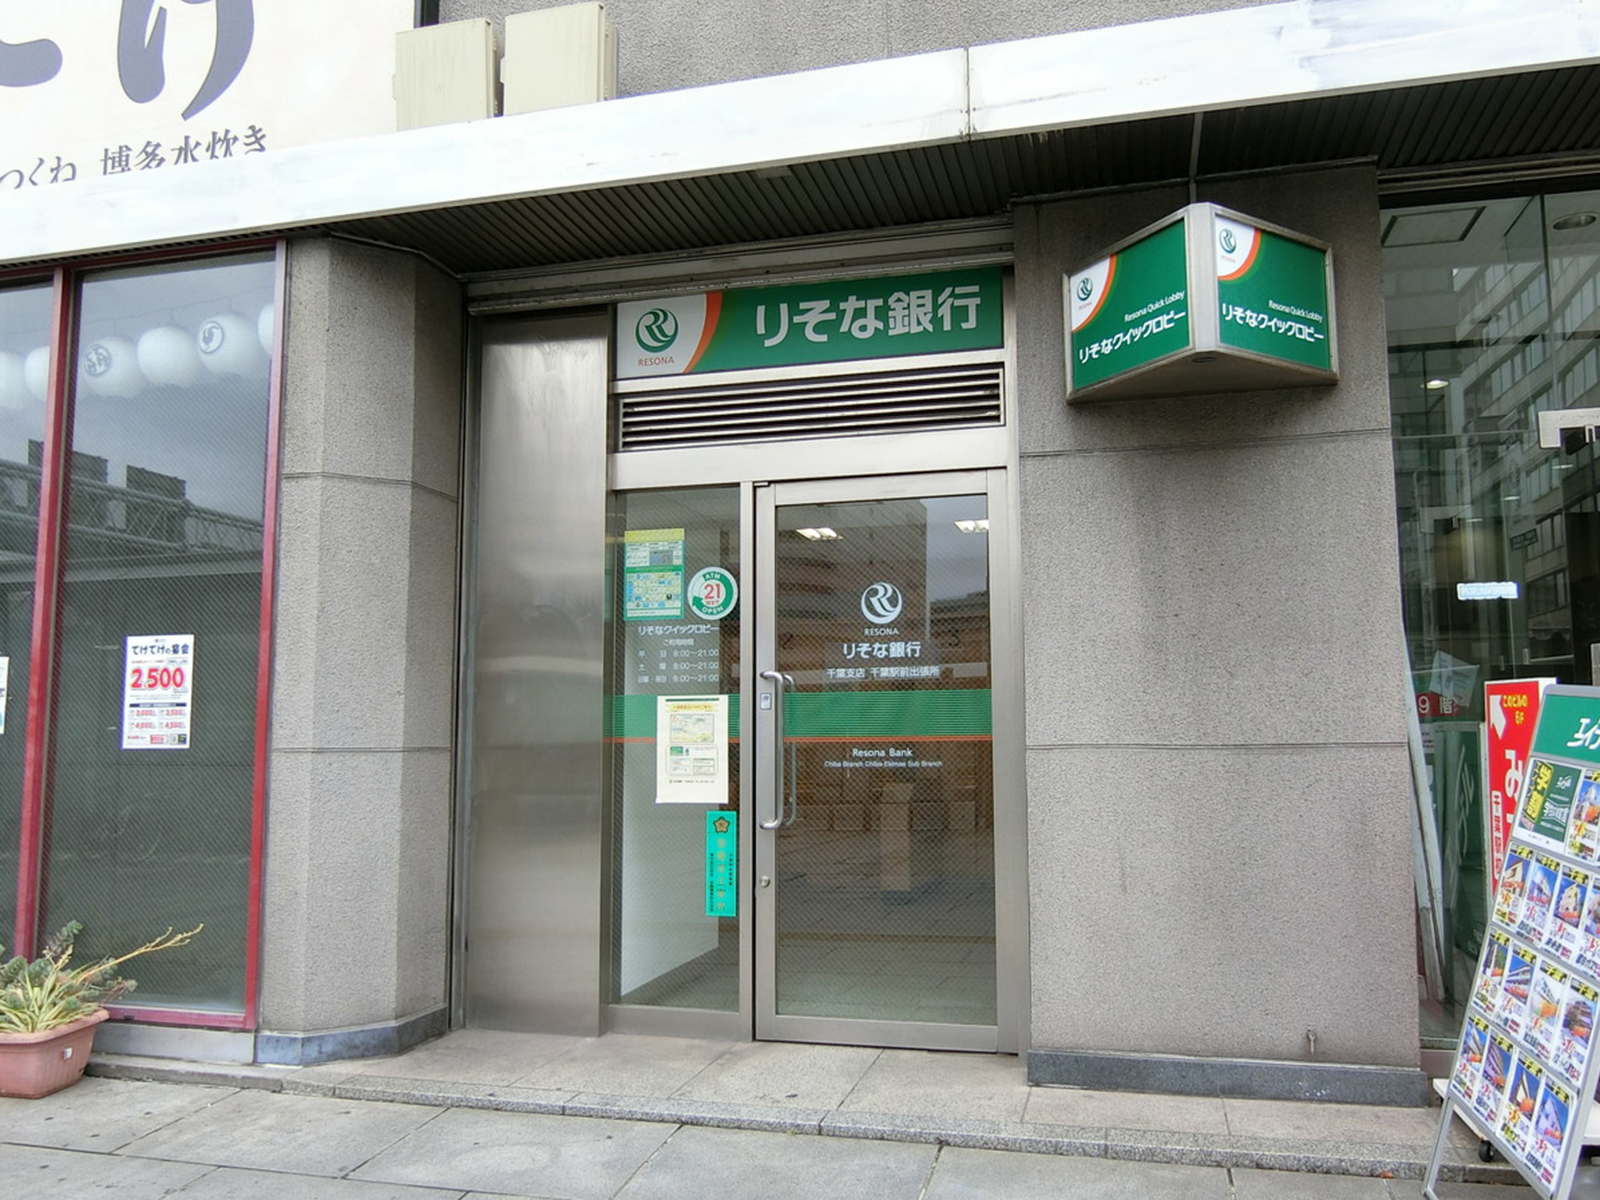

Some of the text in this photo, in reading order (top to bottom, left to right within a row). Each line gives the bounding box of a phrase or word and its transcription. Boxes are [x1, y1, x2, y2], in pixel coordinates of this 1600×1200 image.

[100, 125, 267, 176] 博多水炊き
[1124, 290, 1185, 322] Resona Quick Lobby
[1268, 300, 1323, 323] Resona Quick Lobby
[755, 285, 981, 348] りそな銀行
[1222, 303, 1324, 342] りそなクイックロビー
[1079, 310, 1186, 364] りそなクイックロビー
[637, 356, 675, 367] RESONA
[704, 572, 721, 580] ATM
[704, 583, 721, 600] 21
[638, 623, 720, 636] りそなクイックロビー
[864, 628, 900, 636] RESONA
[131, 643, 190, 656] てけてけの宴会
[843, 641, 921, 659] りそな銀行
[852, 747, 913, 757] Resona Bank
[824, 760, 841, 768] Chiba
[843, 760, 863, 768] Branch
[907, 760, 920, 768] Sub
[921, 760, 943, 768] Branch
